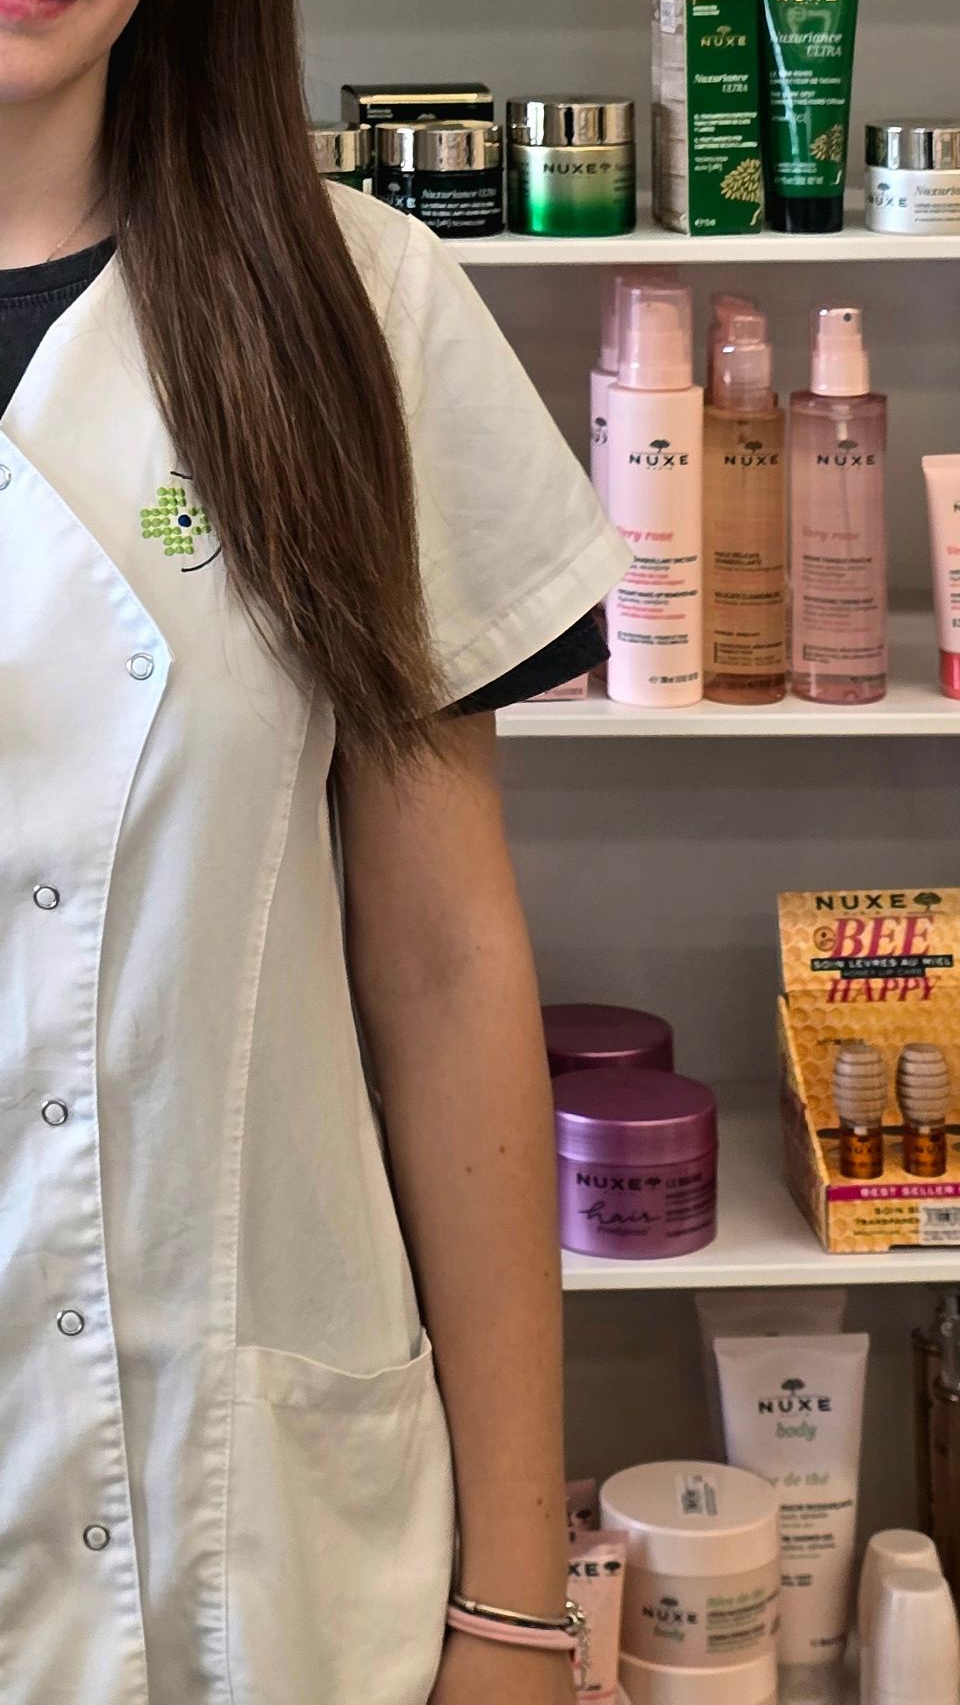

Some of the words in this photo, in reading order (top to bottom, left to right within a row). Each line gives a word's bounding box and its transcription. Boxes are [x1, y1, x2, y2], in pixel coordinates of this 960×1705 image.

[700, 36, 747, 47] NUXE
[806, 45, 843, 58] ULTRA
[543, 163, 597, 176] NUXE
[629, 453, 688, 468] NUXE
[724, 453, 779, 468] NUXE
[816, 453, 876, 468] NUXE
[816, 894, 908, 911] NUXE
[829, 915, 935, 959] BEE
[813, 960, 845, 970] SOIN
[901, 958, 919, 967] AU
[922, 956, 952, 967] MIEL
[825, 976, 942, 1004] HAPPY
[576, 1172, 642, 1191] NUXE
[860, 1187, 897, 1198] BEST
[757, 1398, 832, 1414] NUXE
[775, 1421, 818, 1441] body
[642, 1606, 698, 1624] NUXE
